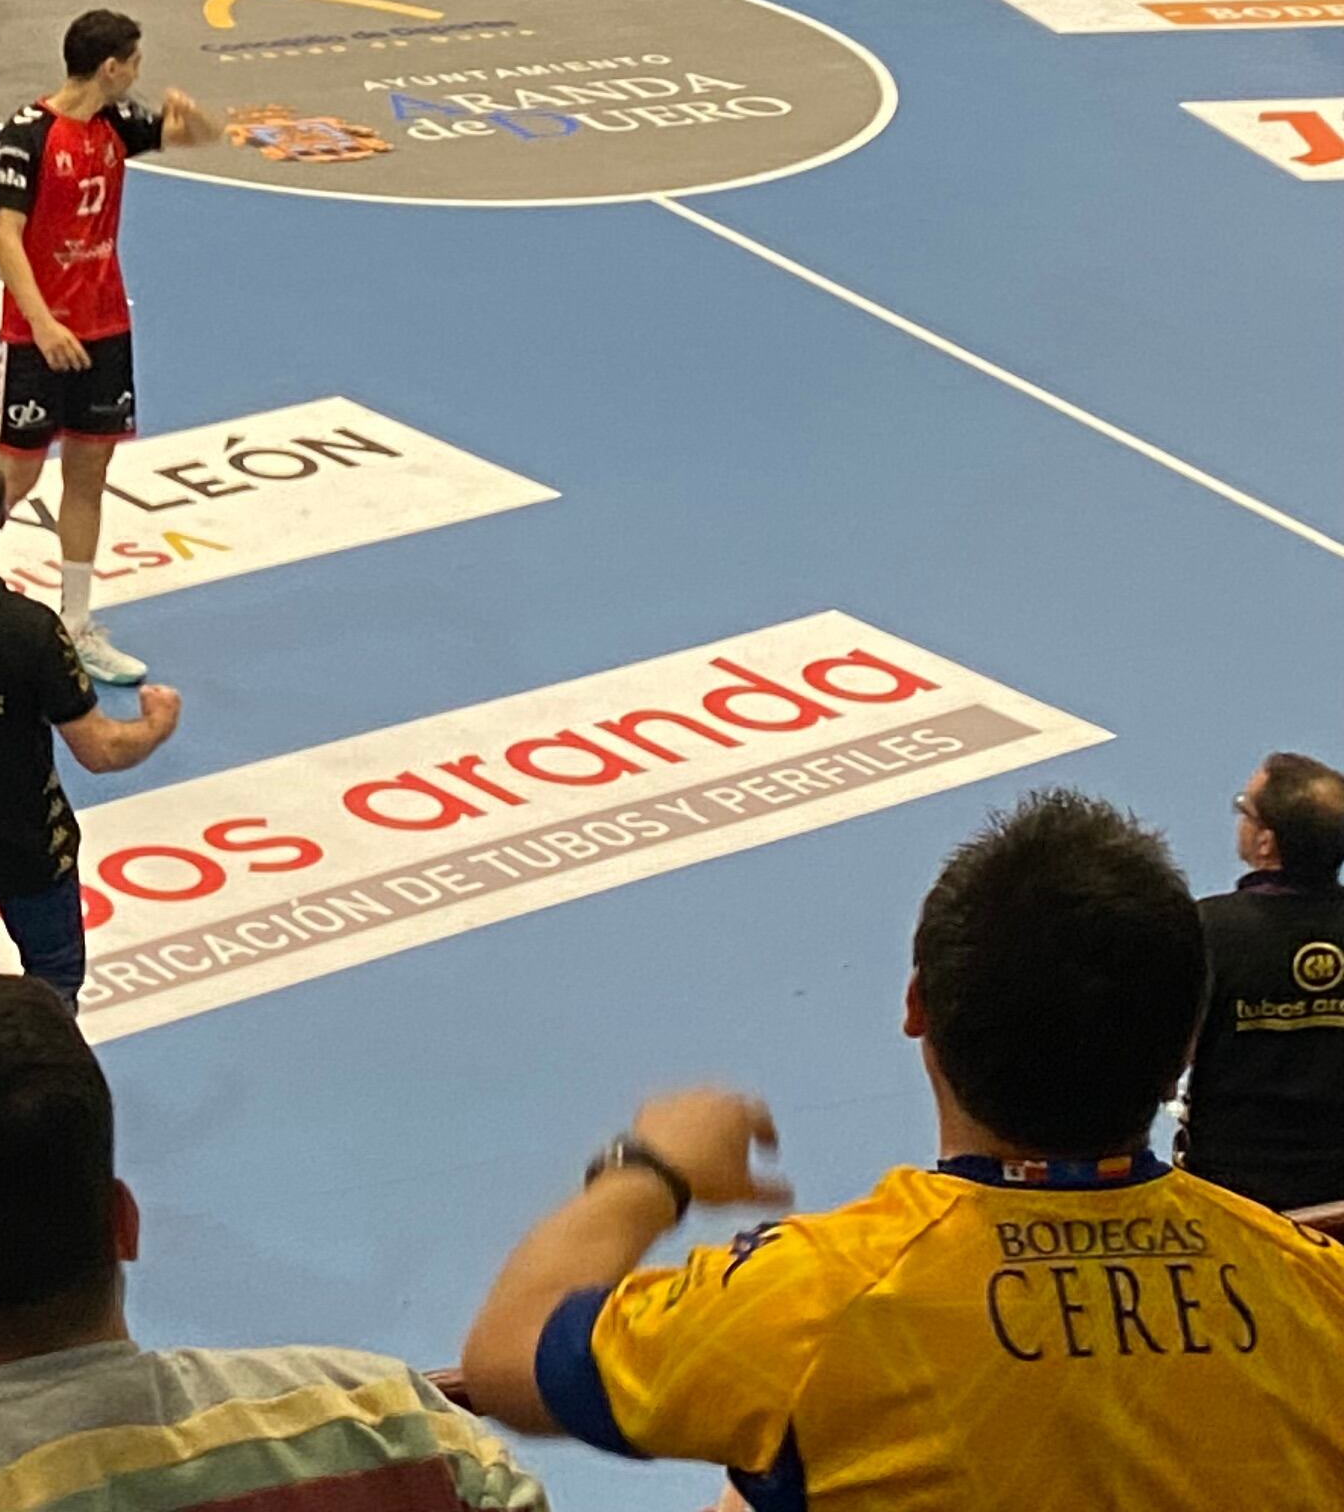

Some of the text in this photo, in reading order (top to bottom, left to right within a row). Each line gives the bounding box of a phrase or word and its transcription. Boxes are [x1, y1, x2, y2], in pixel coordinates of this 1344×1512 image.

[363, 53, 673, 92] AYUNTAMIENTO
[387, 70, 748, 121] ARANDA
[406, 95, 793, 143] de DUERO
[102, 426, 405, 513] LEÓN
[342, 645, 944, 833] aranda
[77, 725, 964, 1006] BRICACIÓN DE TUBOS Y PERFILES
[1235, 999, 1307, 1019] tubos
[995, 1217, 1209, 1257] BODEGAS
[985, 1262, 1258, 1362] CERES
